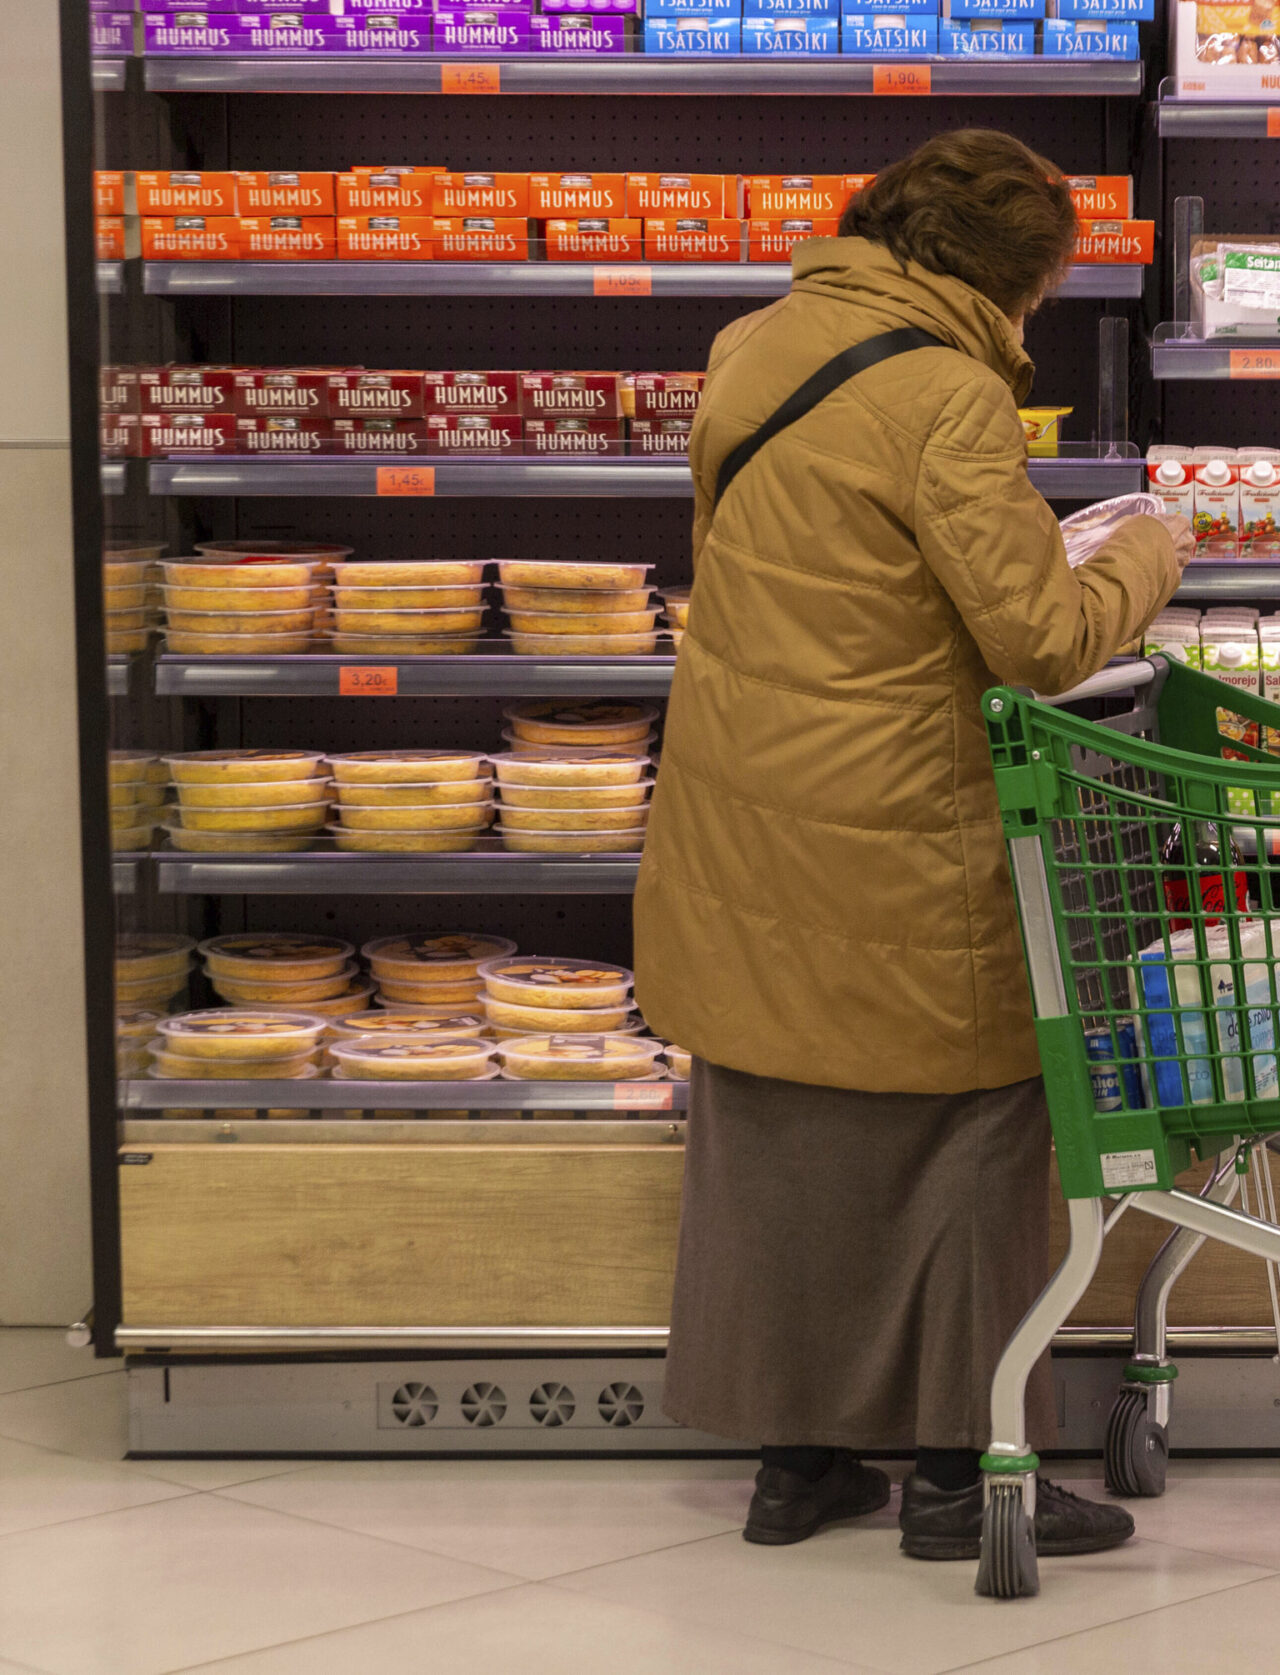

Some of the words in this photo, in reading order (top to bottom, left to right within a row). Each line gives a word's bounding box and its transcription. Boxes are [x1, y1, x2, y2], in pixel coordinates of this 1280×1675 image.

[156, 28, 230, 47] HUMMUS
[251, 29, 325, 47] HUMMUS
[347, 30, 420, 48] HUMMUS
[445, 26, 519, 45] HUMMUS
[541, 29, 614, 48] HUMMUS
[656, 31, 730, 50] TSATSIKI
[754, 32, 828, 51] TSATSIKI
[855, 29, 928, 48] TSATSIKI
[951, 33, 1024, 52] TSATSIKI
[1055, 34, 1128, 52] TSATSIKI
[149, 189, 224, 207] HUMMUS
[248, 189, 322, 207] HUMMUS
[348, 190, 423, 208] HUMMUS
[444, 190, 518, 208] HUMMUS
[540, 190, 614, 208] HUMMUS
[639, 191, 712, 209] HUMMUS
[762, 192, 833, 210] HUMMUS
[154, 233, 228, 251] HUMMUS
[250, 233, 324, 251] HUMMUS
[348, 233, 421, 251] HUMMUS
[443, 234, 516, 252] HUMMUS
[558, 234, 630, 252] HUMMUS
[656, 235, 729, 253] HUMMUS
[150, 386, 224, 405] HUMMUS
[246, 388, 319, 407] HUMMUS
[339, 389, 412, 408] HUMMUS
[435, 386, 508, 405] HUMMUS
[533, 389, 606, 408] HUMMUS
[646, 391, 702, 409] HUMM
[151, 428, 225, 446] HUMMUS
[248, 432, 321, 450] HUMMUS
[344, 432, 417, 450] HUMMUS
[438, 429, 512, 447] HUMMUS
[536, 432, 609, 451] HUMMUS
